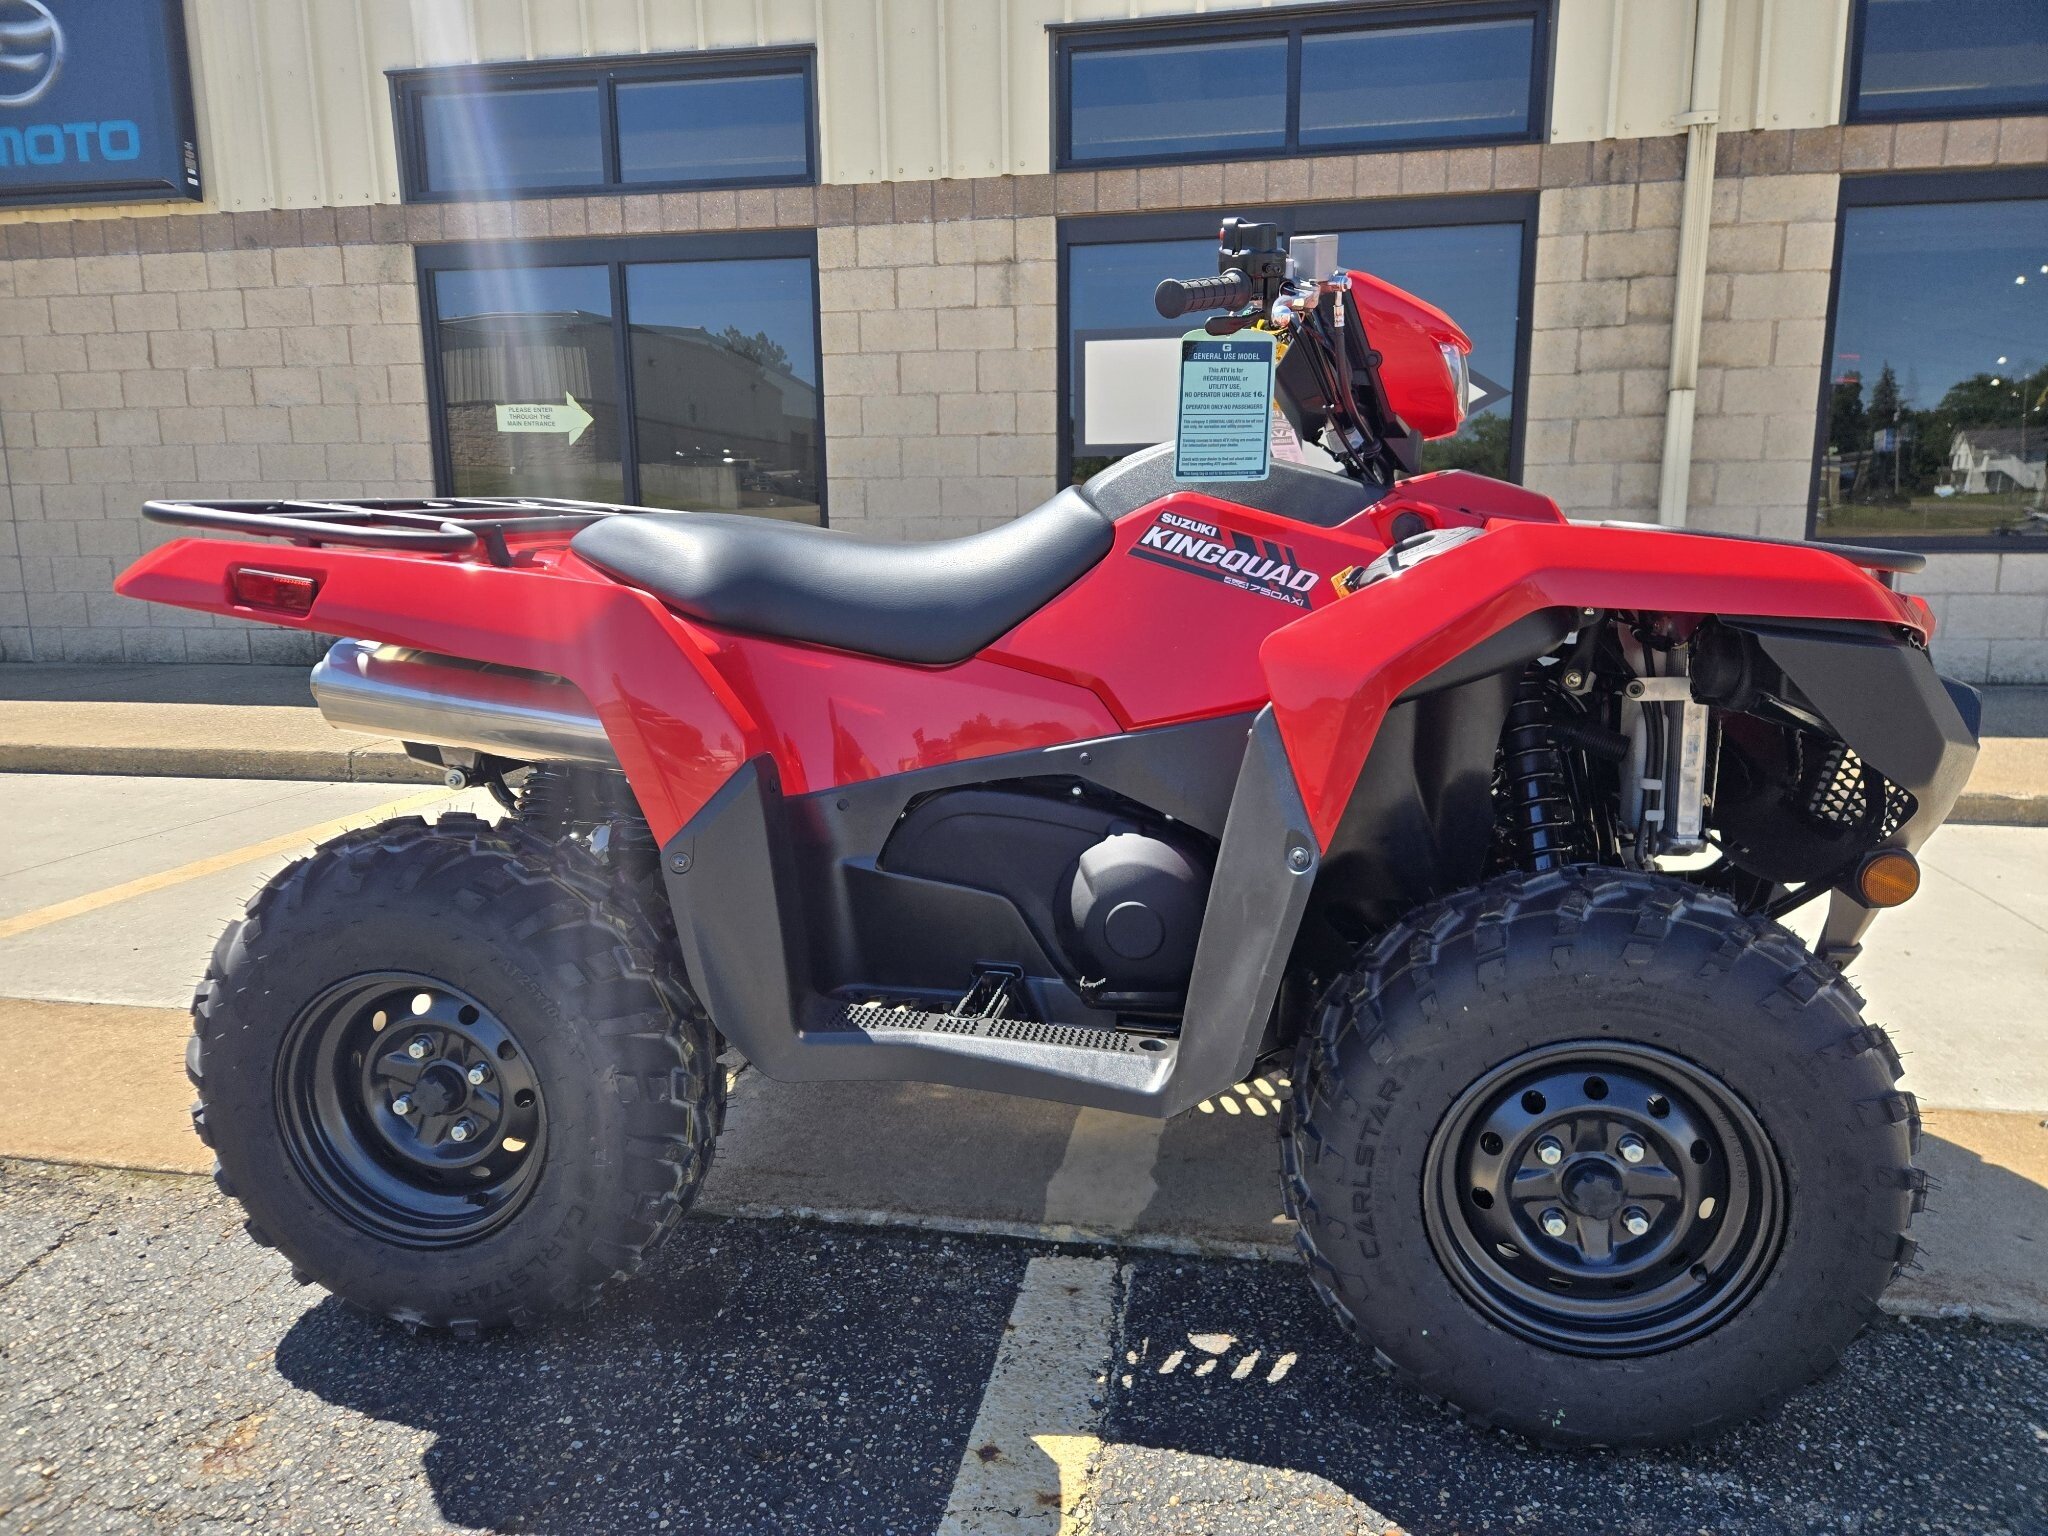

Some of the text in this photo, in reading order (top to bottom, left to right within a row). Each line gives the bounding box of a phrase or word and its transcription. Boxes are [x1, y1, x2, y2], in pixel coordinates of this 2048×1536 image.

[1193, 352, 1260, 360] GENERAL USE MODEL
[1160, 513, 1217, 537] SUZUKI
[1140, 525, 1320, 592] KINGQUAD
[1352, 1076, 1402, 1260] CARLSTAR
